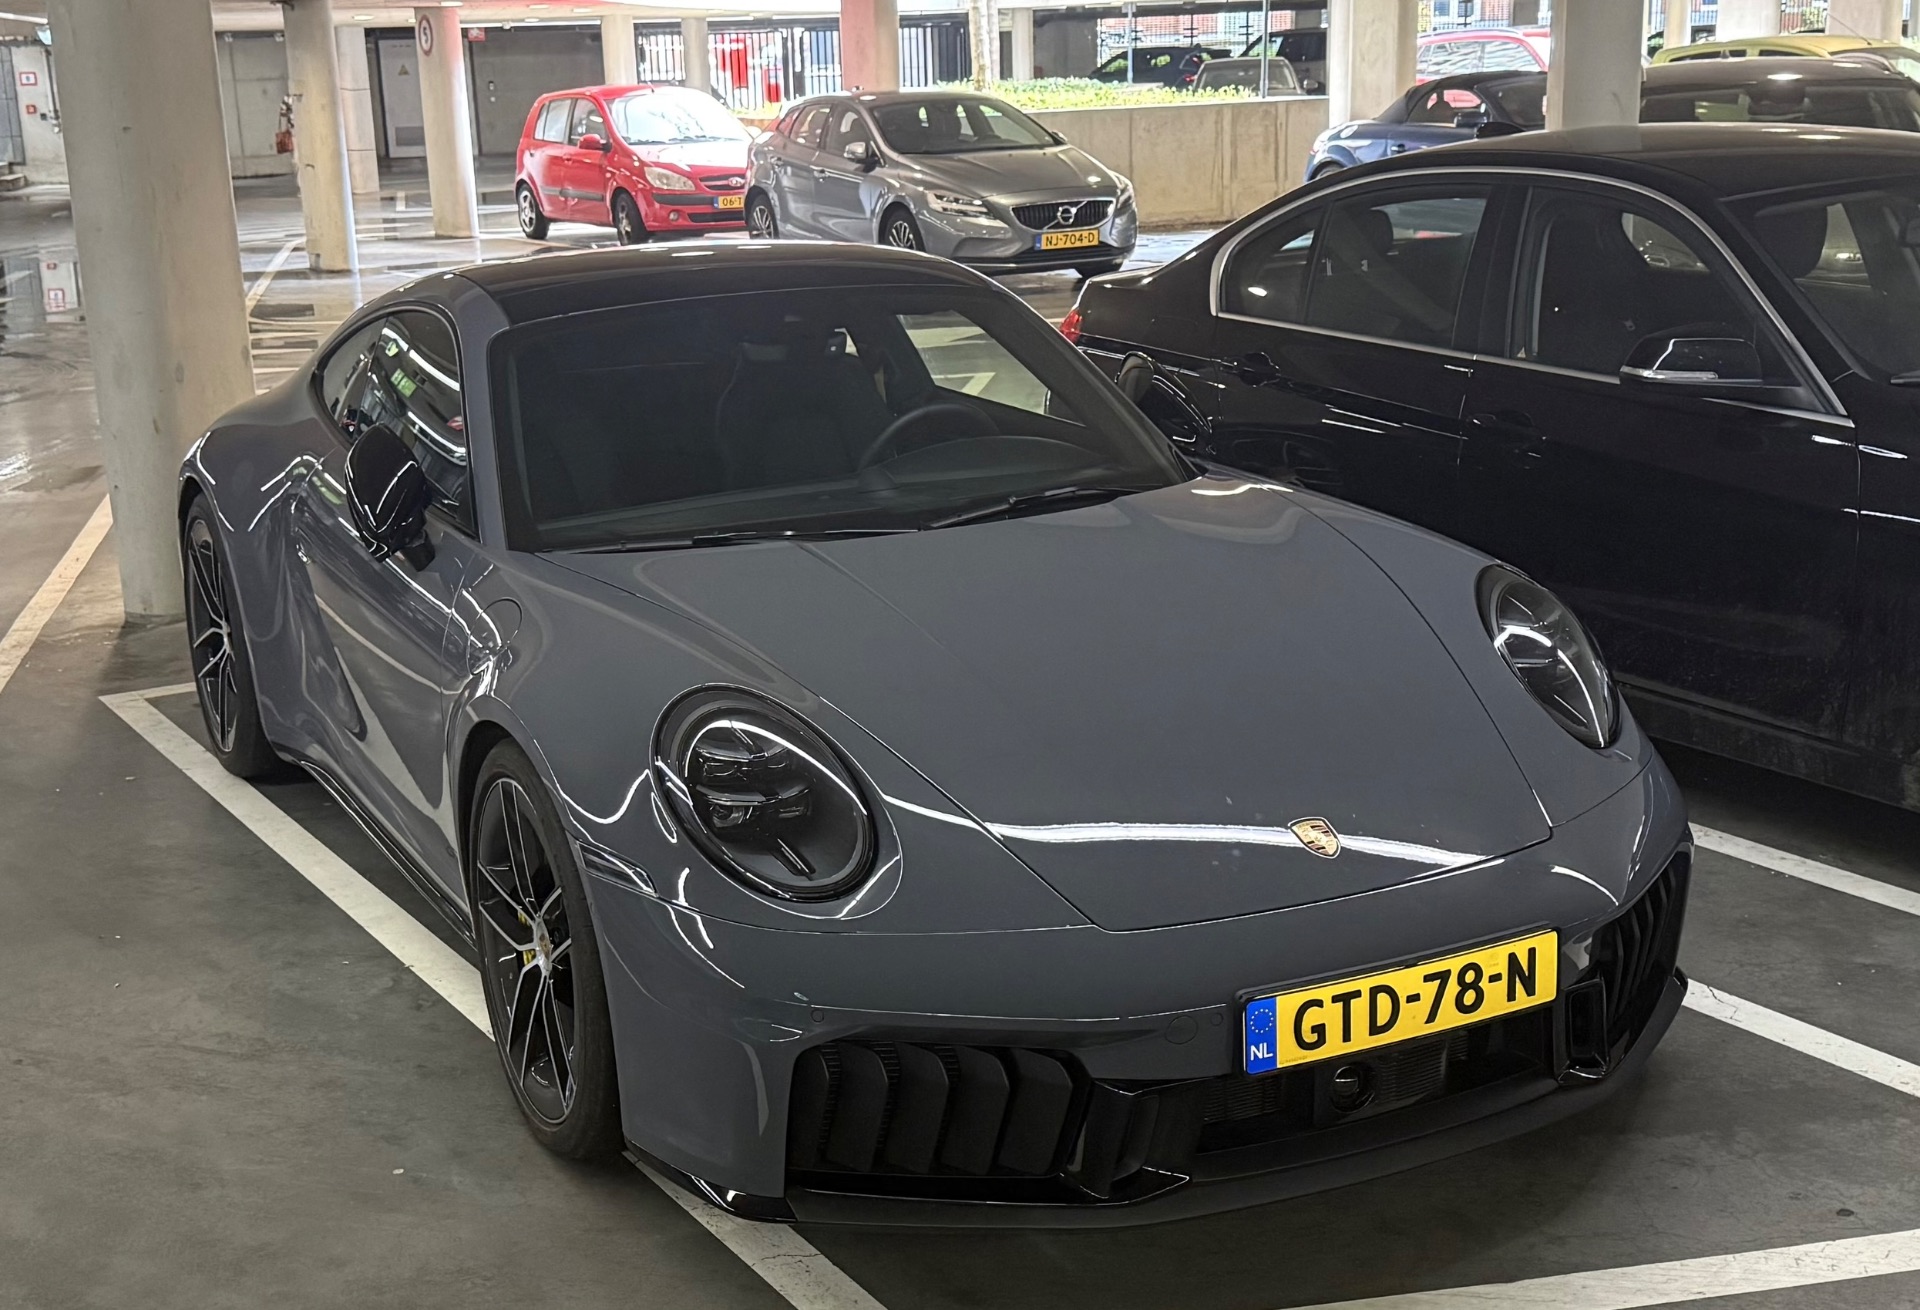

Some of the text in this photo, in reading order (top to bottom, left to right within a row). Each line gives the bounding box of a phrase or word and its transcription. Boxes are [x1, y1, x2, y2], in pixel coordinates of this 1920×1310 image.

[422, 26, 429, 44] 5
[1045, 232, 1095, 246] NJ-704-D
[1293, 947, 1537, 1051] GTD-78-N
[1250, 1042, 1274, 1061] NL
